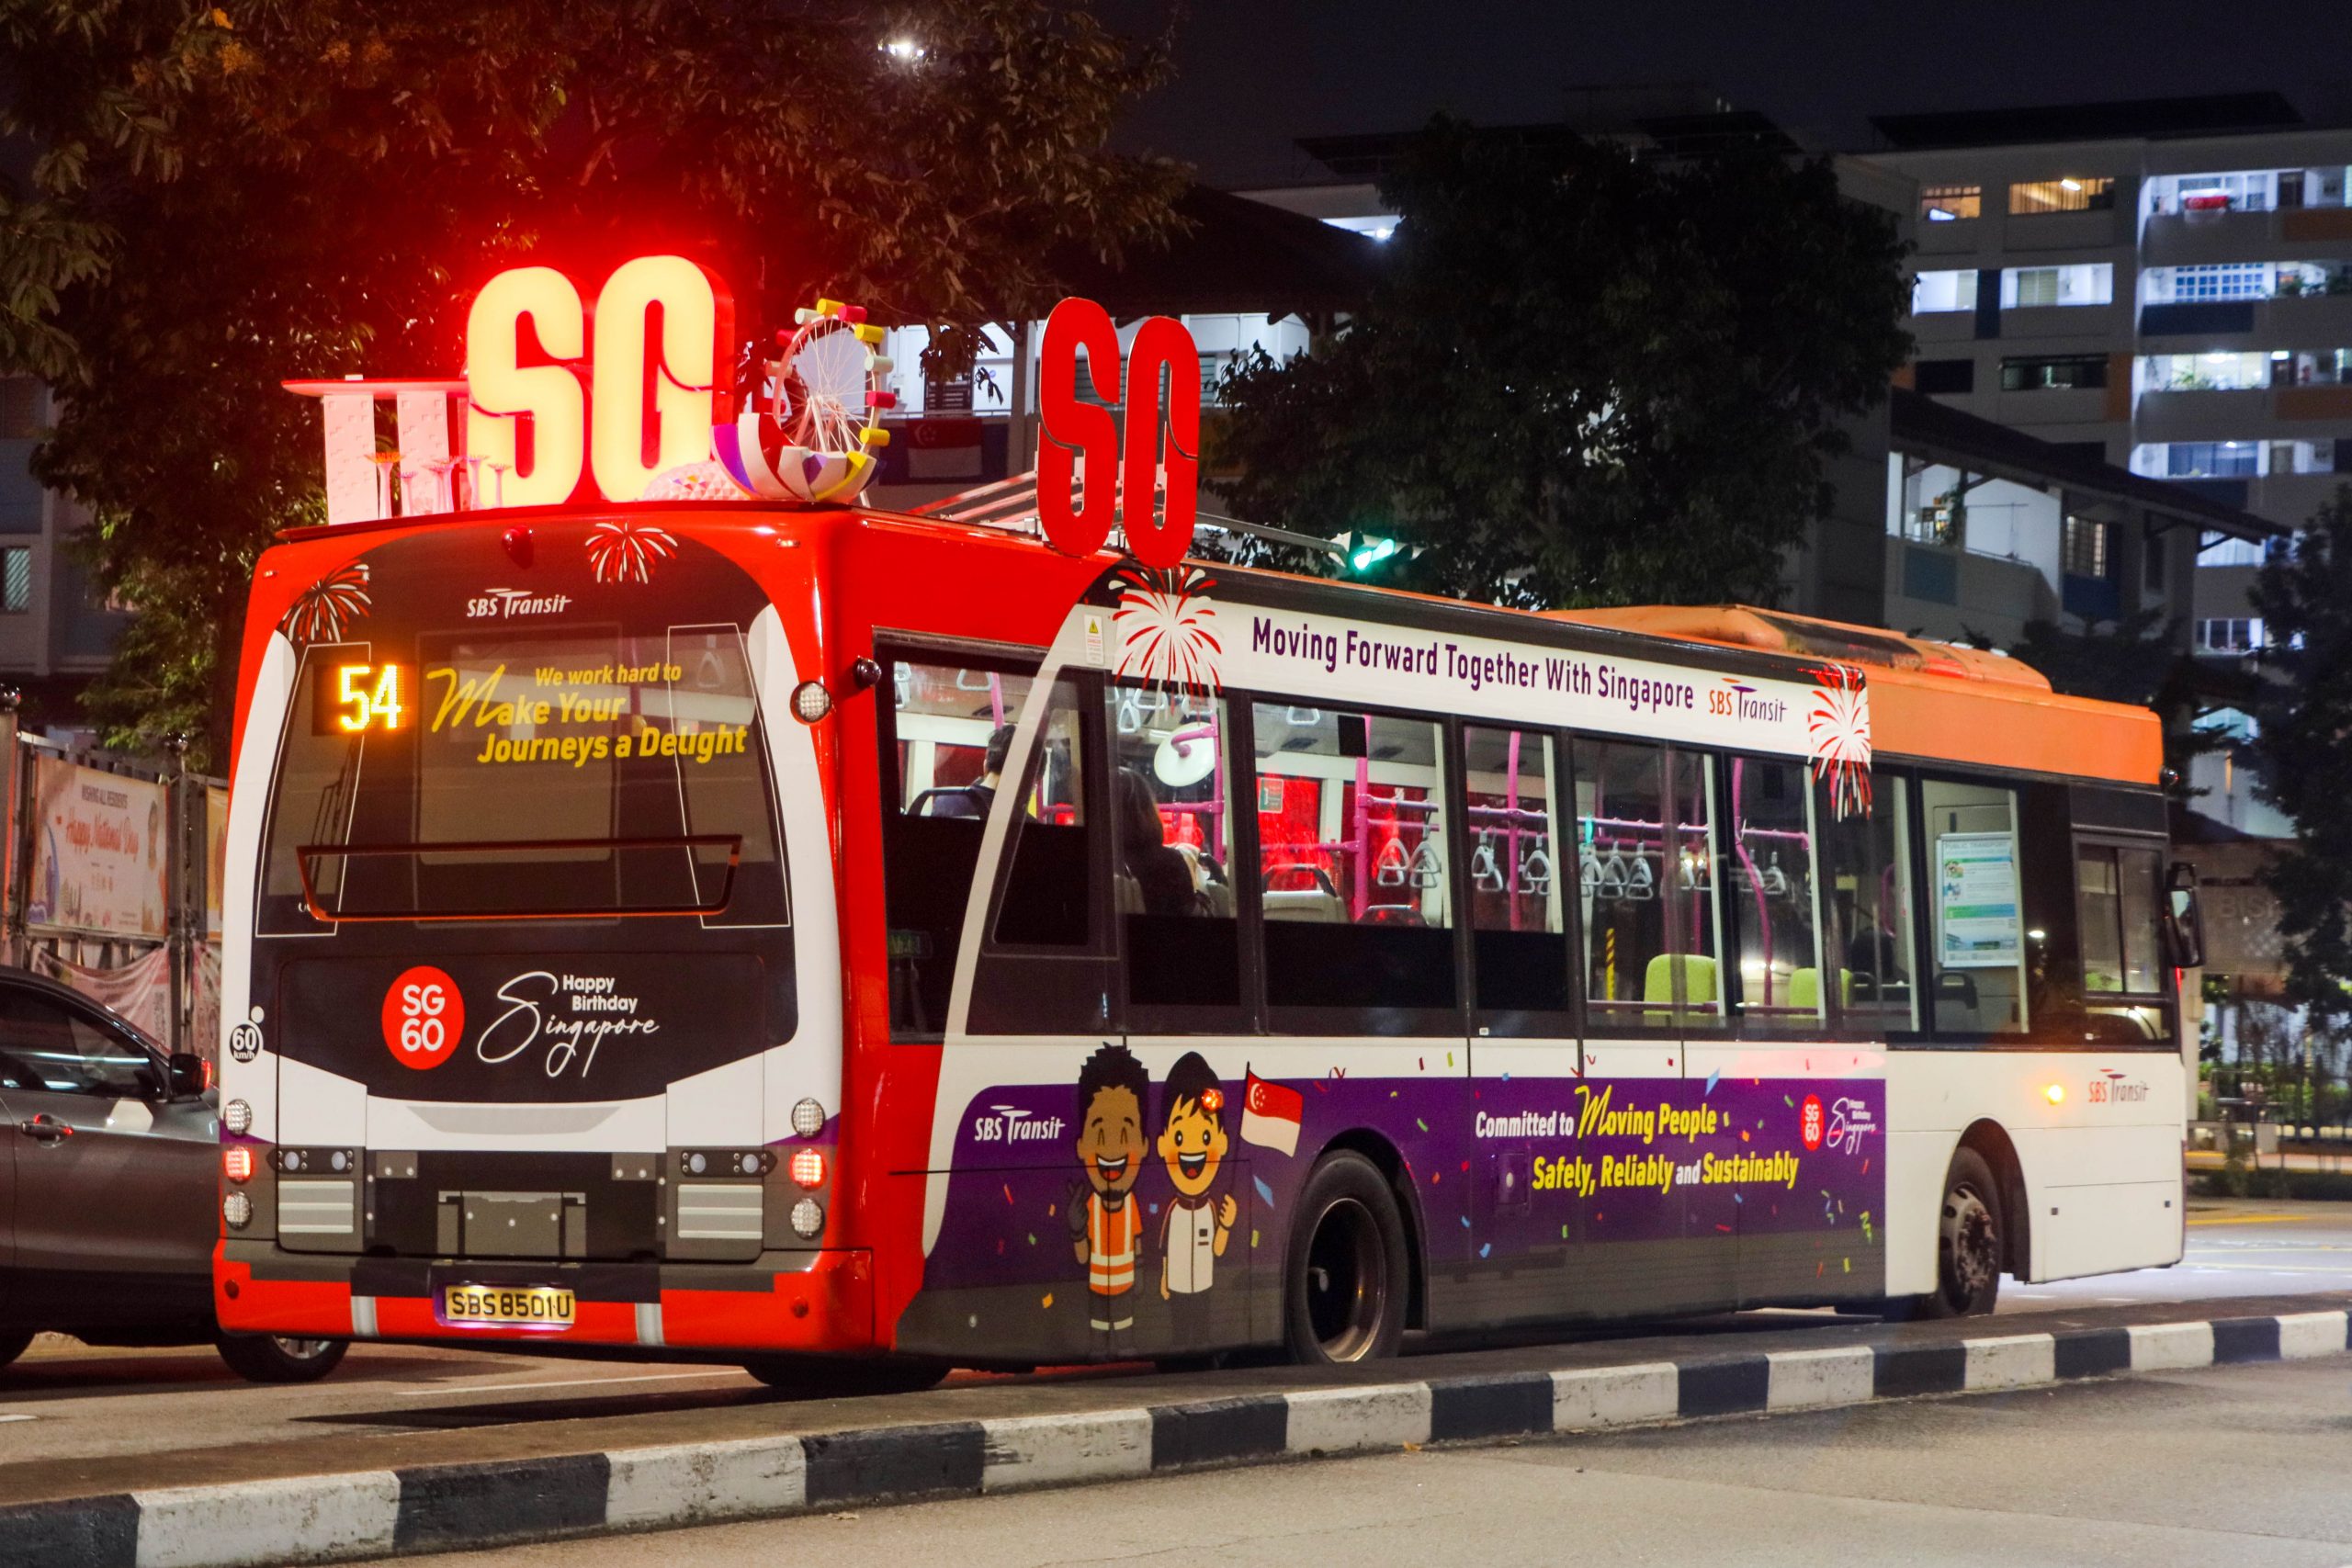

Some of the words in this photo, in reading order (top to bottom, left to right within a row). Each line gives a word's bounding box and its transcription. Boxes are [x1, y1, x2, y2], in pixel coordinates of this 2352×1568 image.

[467, 254, 717, 505] SG
[467, 596, 499, 617] SBS
[501, 589, 573, 619] Transit
[535, 667, 565, 688] We
[568, 666, 614, 686] work
[616, 663, 660, 684] hard
[662, 663, 683, 682] to
[1252, 615, 1338, 673] Moving
[1346, 630, 1439, 677] Forward
[1446, 645, 1541, 692] Together
[1544, 659, 1591, 695] With
[1599, 665, 1694, 714] Singapore
[339, 665, 403, 731] 54
[427, 664, 550, 733] Make
[559, 691, 626, 724] Your
[1709, 687, 1734, 716] SBS
[1732, 684, 1788, 724] Transit
[477, 732, 608, 768] Journeys
[615, 737, 632, 757] a
[639, 725, 748, 764] Delight
[401, 984, 446, 1017] SG
[562, 975, 616, 996] Happy
[571, 993, 639, 1015] Birthday
[232, 1027, 257, 1051] 60
[401, 1019, 445, 1054] 60
[477, 971, 661, 1078] Singapore
[233, 1050, 255, 1060] km/h
[2088, 1081, 2108, 1103] SBS
[2107, 1074, 2151, 1106] Transit
[974, 1116, 1002, 1142] SBS
[1001, 1110, 1066, 1145] Transit
[1476, 1110, 1556, 1140] Committed
[1559, 1112, 1574, 1137] to
[1575, 1085, 1655, 1145] Moving
[1658, 1103, 1717, 1142] People
[1804, 1103, 1820, 1122] SG
[1804, 1122, 1820, 1142] 60
[1532, 1154, 1596, 1198] Safely,
[1600, 1152, 1674, 1193] Reliably
[1676, 1161, 1701, 1186] and
[1702, 1151, 1799, 1191] Sustainably
